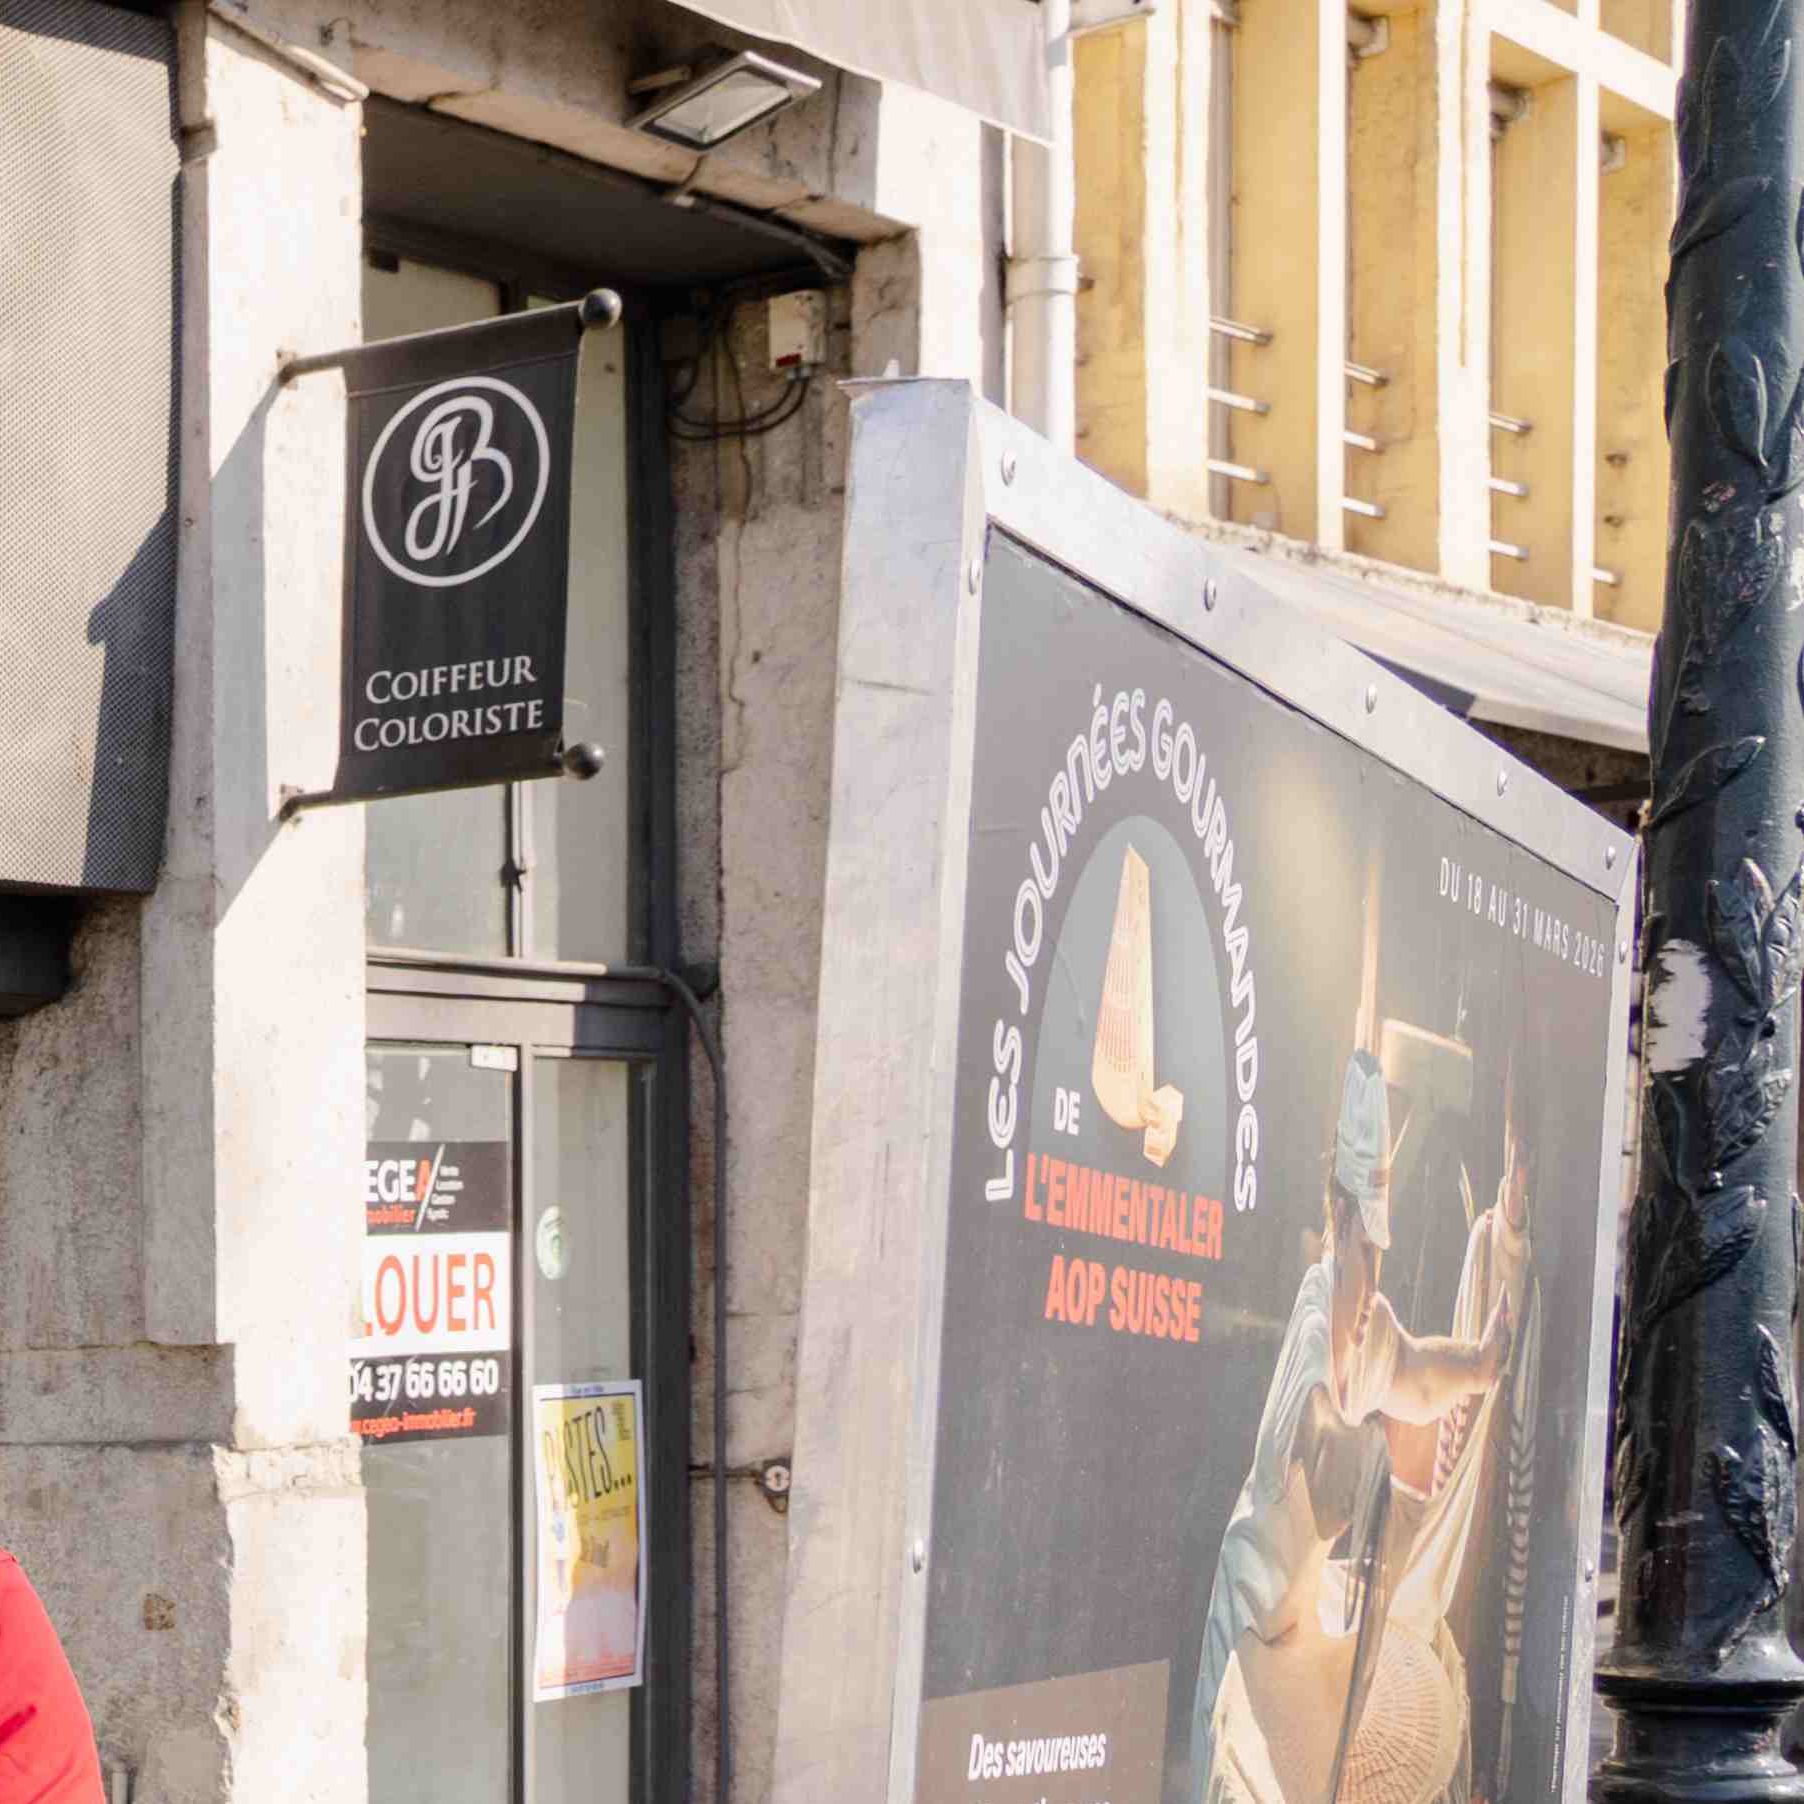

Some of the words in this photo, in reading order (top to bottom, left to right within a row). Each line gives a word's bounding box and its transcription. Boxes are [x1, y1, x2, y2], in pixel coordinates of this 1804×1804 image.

[365, 654, 537, 705] COIFFEUR
[353, 700, 545, 752] COLORISTE
[985, 1018, 1023, 1202] LES
[1004, 682, 1146, 1015] JOURNÉES
[1152, 697, 1261, 1213] GOURMANDES
[1439, 856, 1462, 903] DU
[1466, 872, 1484, 916] 18
[1487, 884, 1508, 928] AU
[1512, 897, 1530, 940] 31
[1532, 907, 1570, 961] MARS
[1573, 930, 1606, 979] 2026
[1053, 1087, 1081, 1136] DE
[1023, 1151, 1225, 1261] L'EMMENTALER
[365, 1253, 497, 1337] OUER
[1043, 1254, 1107, 1331] AOP
[1108, 1265, 1203, 1345] SUISSE
[375, 1363, 403, 1402] 37
[405, 1360, 436, 1399] 66
[438, 1360, 467, 1398] 66
[469, 1358, 499, 1396] 60
[968, 1733, 1004, 1782] Des
[1005, 1731, 1108, 1776] savoureuses
